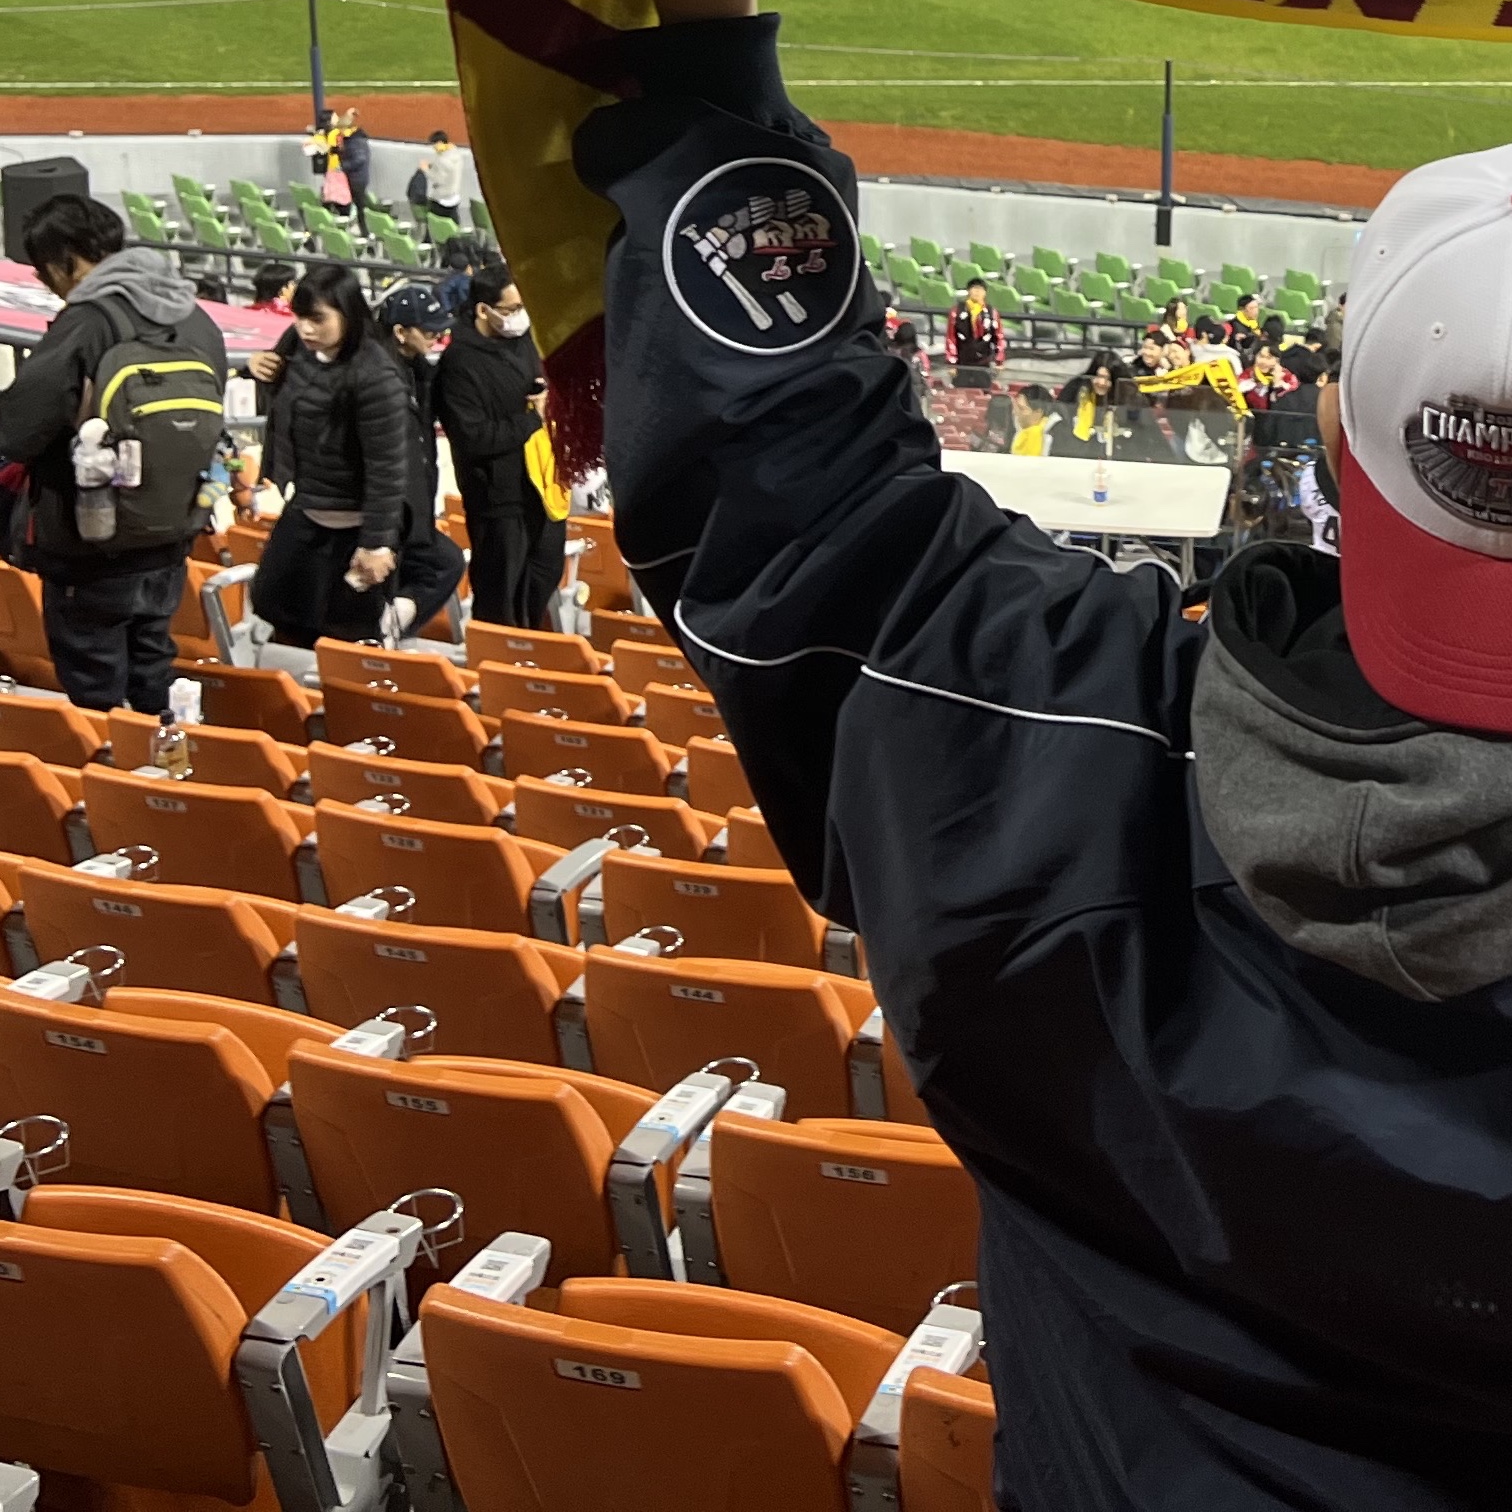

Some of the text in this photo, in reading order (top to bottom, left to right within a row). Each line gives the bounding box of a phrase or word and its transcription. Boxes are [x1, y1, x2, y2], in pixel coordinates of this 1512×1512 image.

[679, 989, 714, 1000] 144
[54, 1034, 95, 1052] 154
[400, 1095, 439, 1113] 155
[572, 1363, 626, 1386] 169
